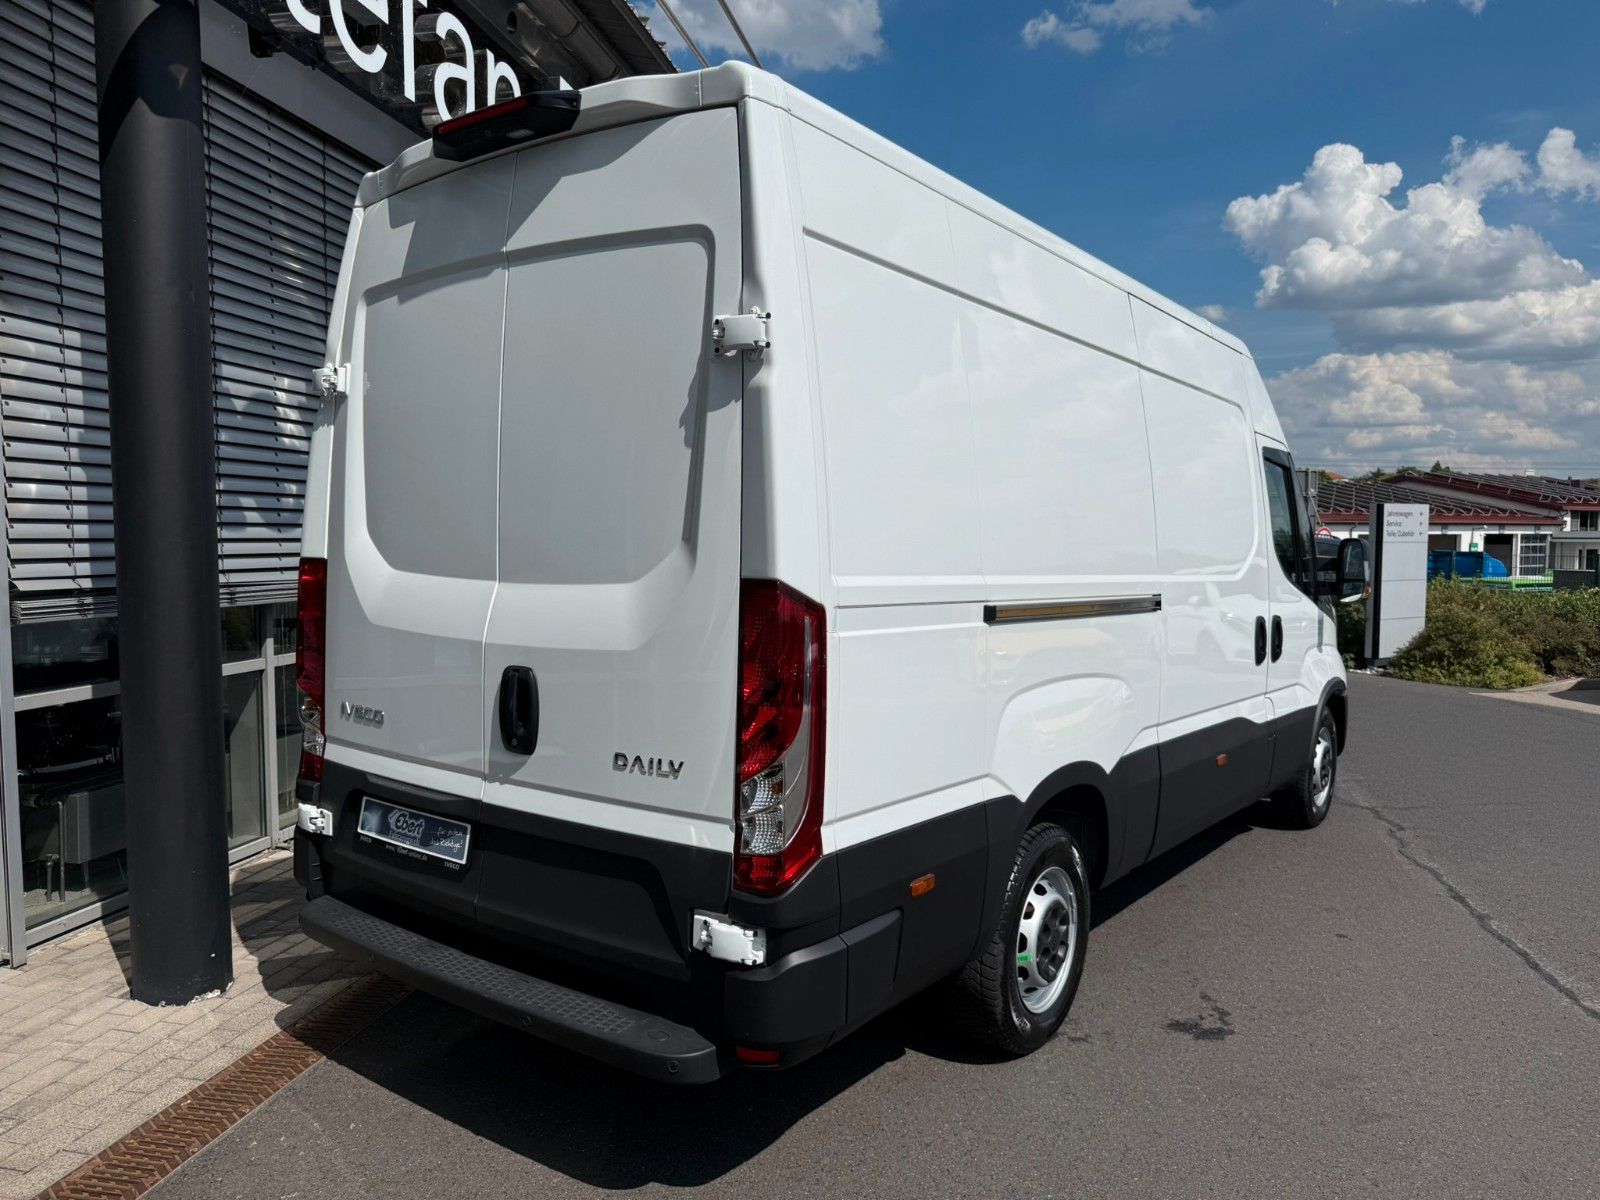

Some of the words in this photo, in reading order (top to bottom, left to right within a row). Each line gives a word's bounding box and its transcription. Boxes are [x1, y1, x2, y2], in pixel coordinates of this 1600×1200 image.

[341, 701, 385, 727] IVECO
[612, 752, 684, 780] DAILY
[444, 861, 460, 870] IVECO
